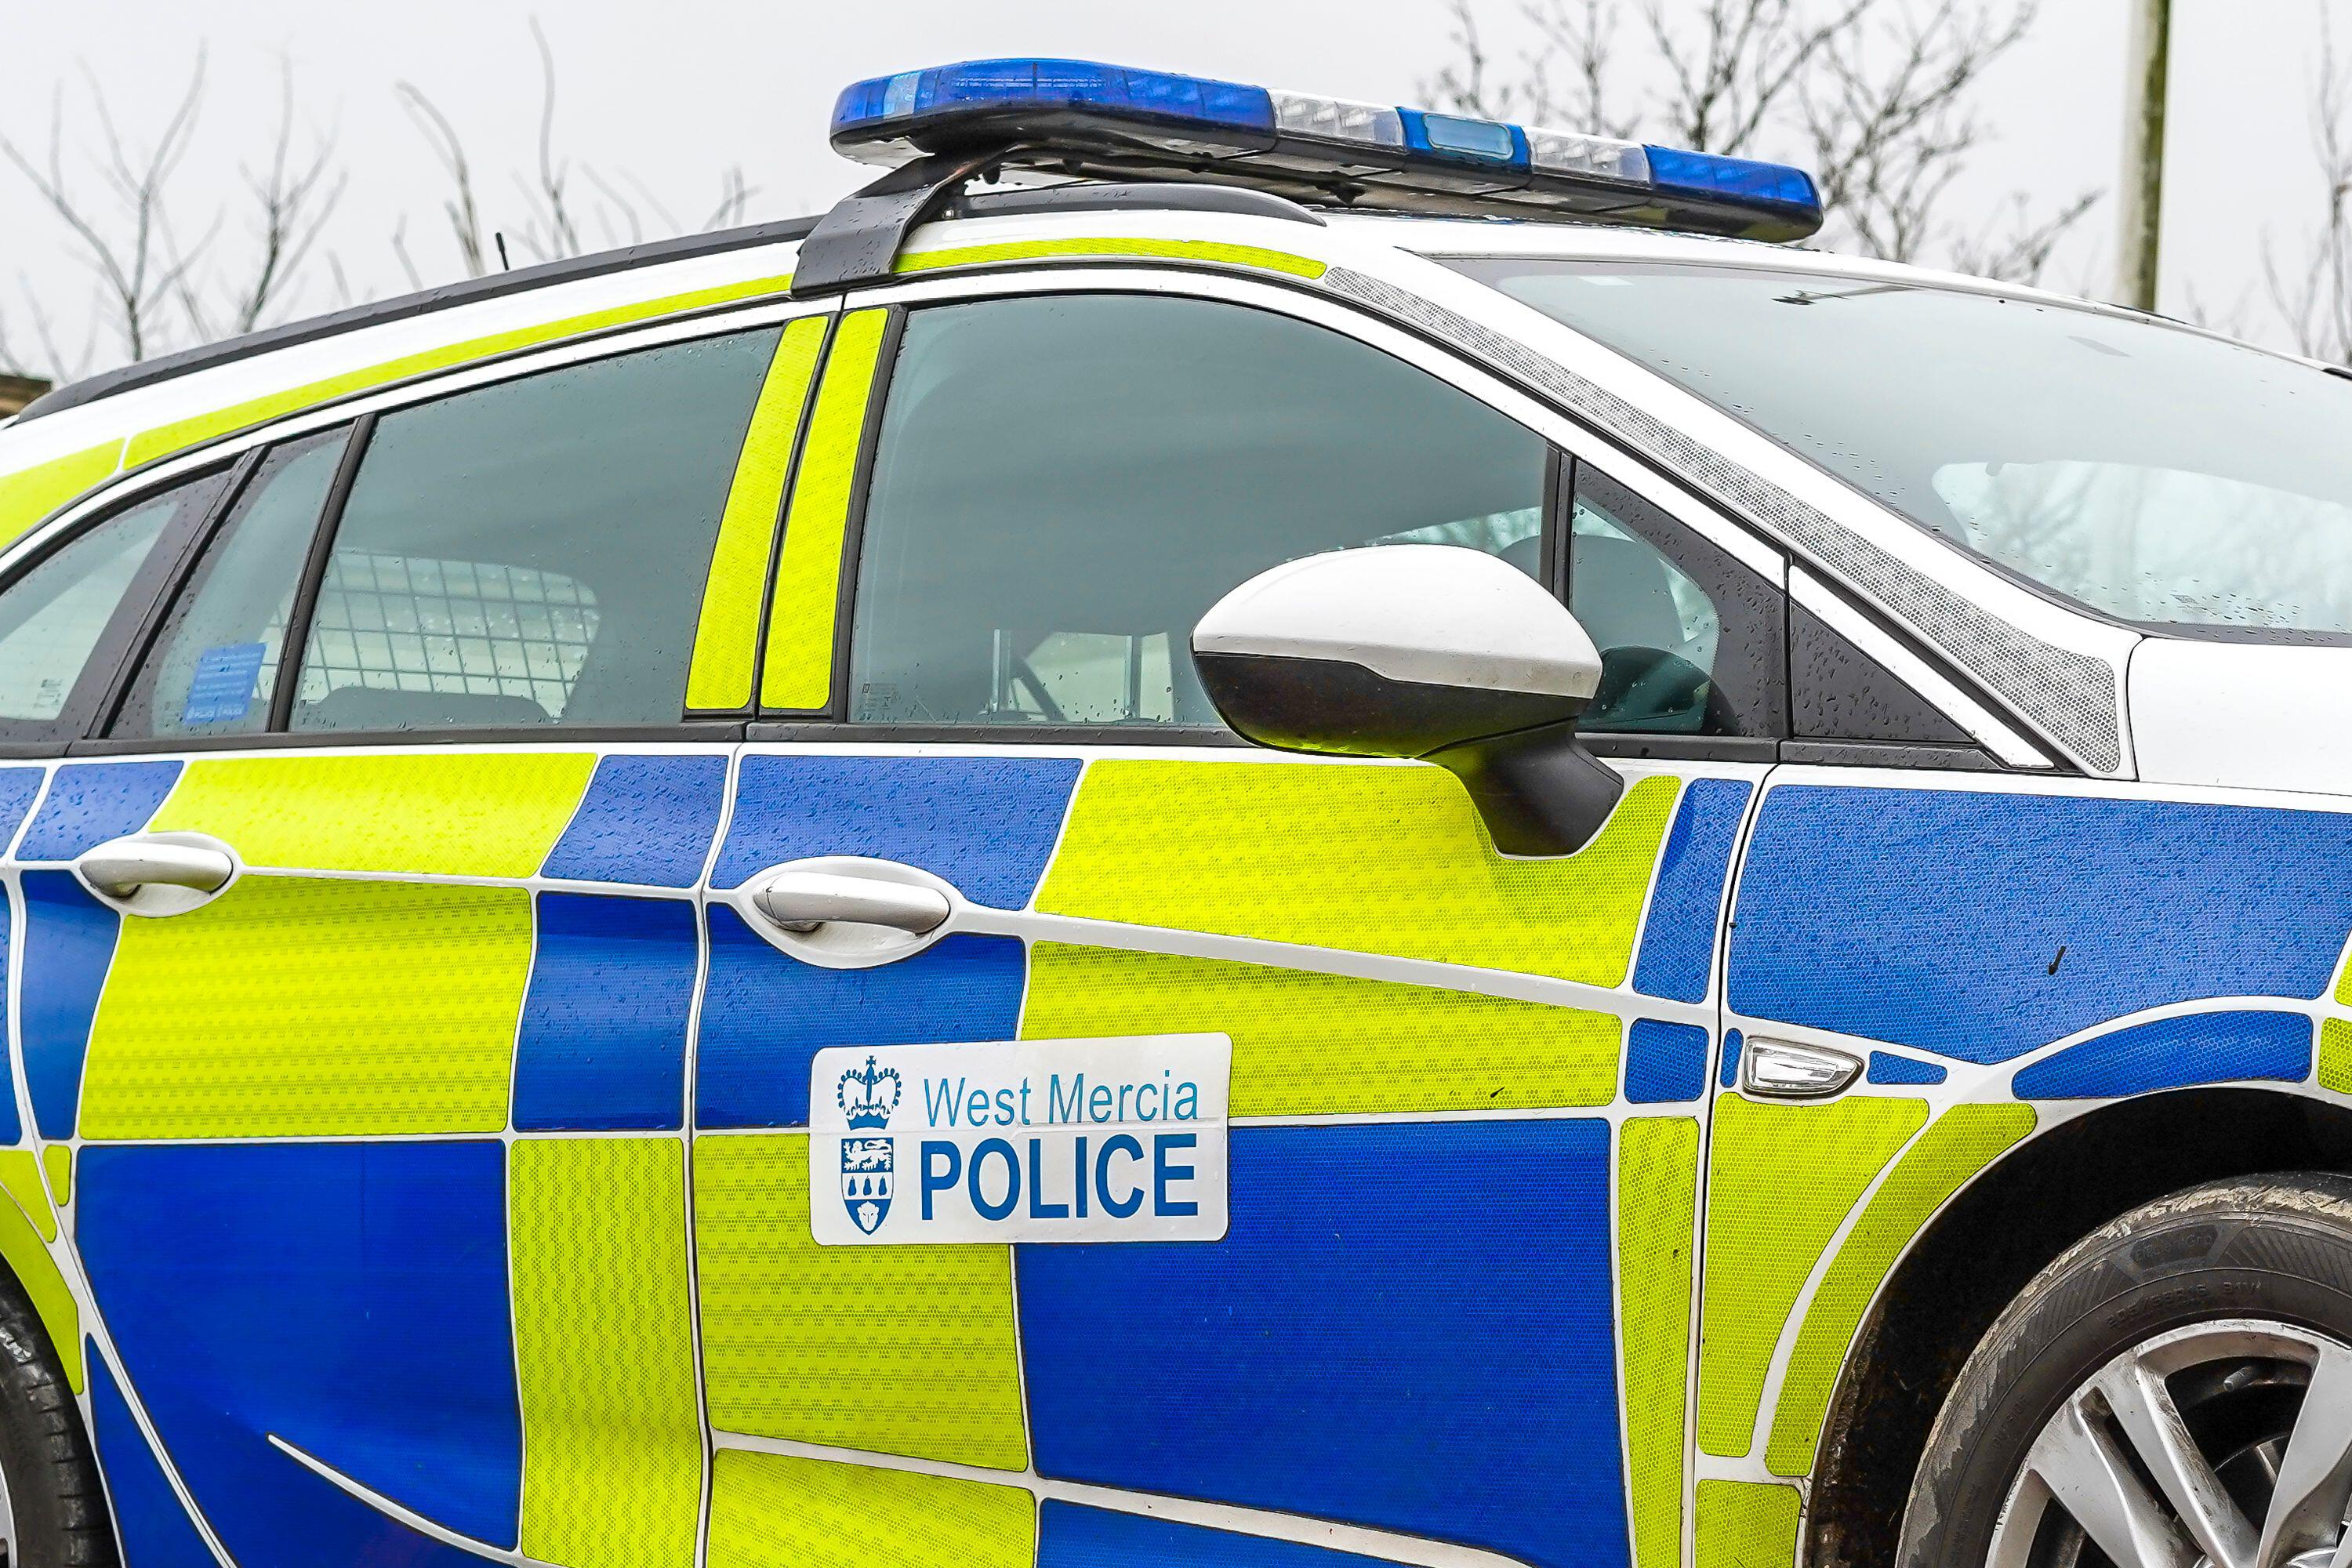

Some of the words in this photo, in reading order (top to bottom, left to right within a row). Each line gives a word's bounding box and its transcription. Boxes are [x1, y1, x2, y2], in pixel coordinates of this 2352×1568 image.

[924, 1076, 1031, 1127] West
[1049, 1069, 1199, 1124] Mercia
[920, 1133, 1199, 1221] POLICE
